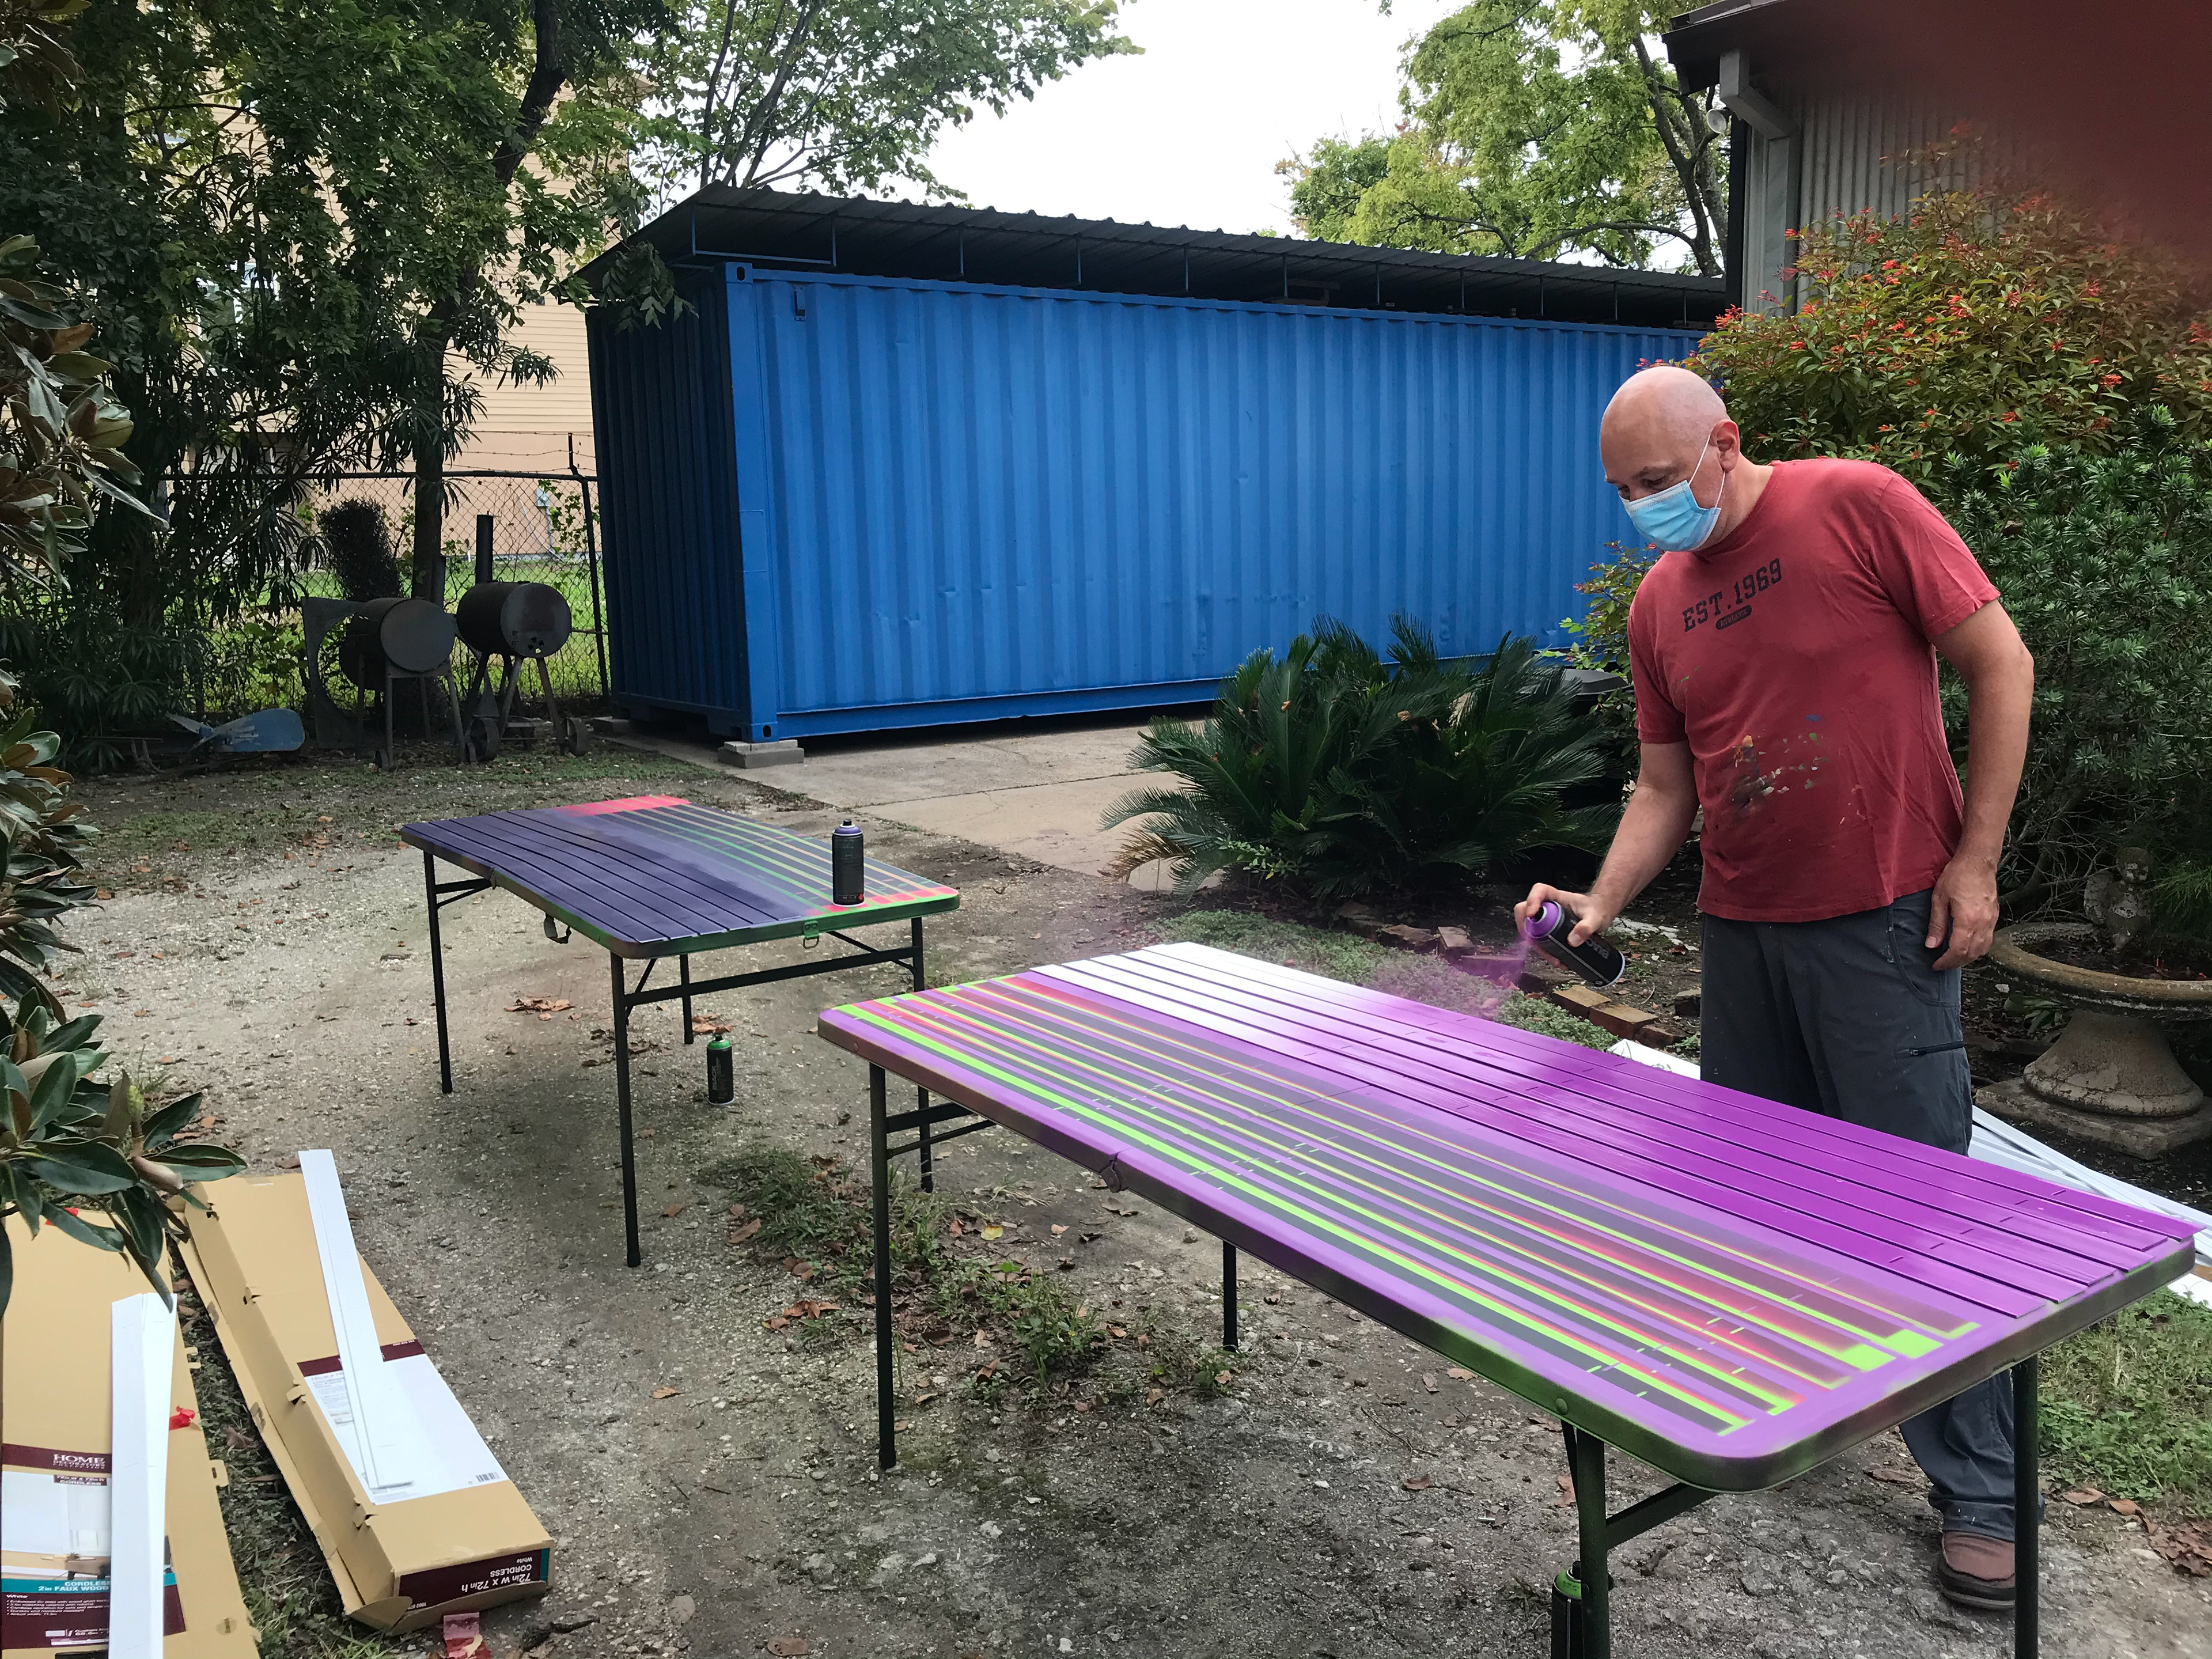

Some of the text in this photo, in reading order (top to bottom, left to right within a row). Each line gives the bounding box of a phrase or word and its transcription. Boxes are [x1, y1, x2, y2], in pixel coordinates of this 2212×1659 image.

[53, 1453, 105, 1464] HOME
[490, 1564, 532, 1577] CORDLESS
[512, 1573, 531, 1582] 72in
[470, 1580, 489, 1590] 72in
